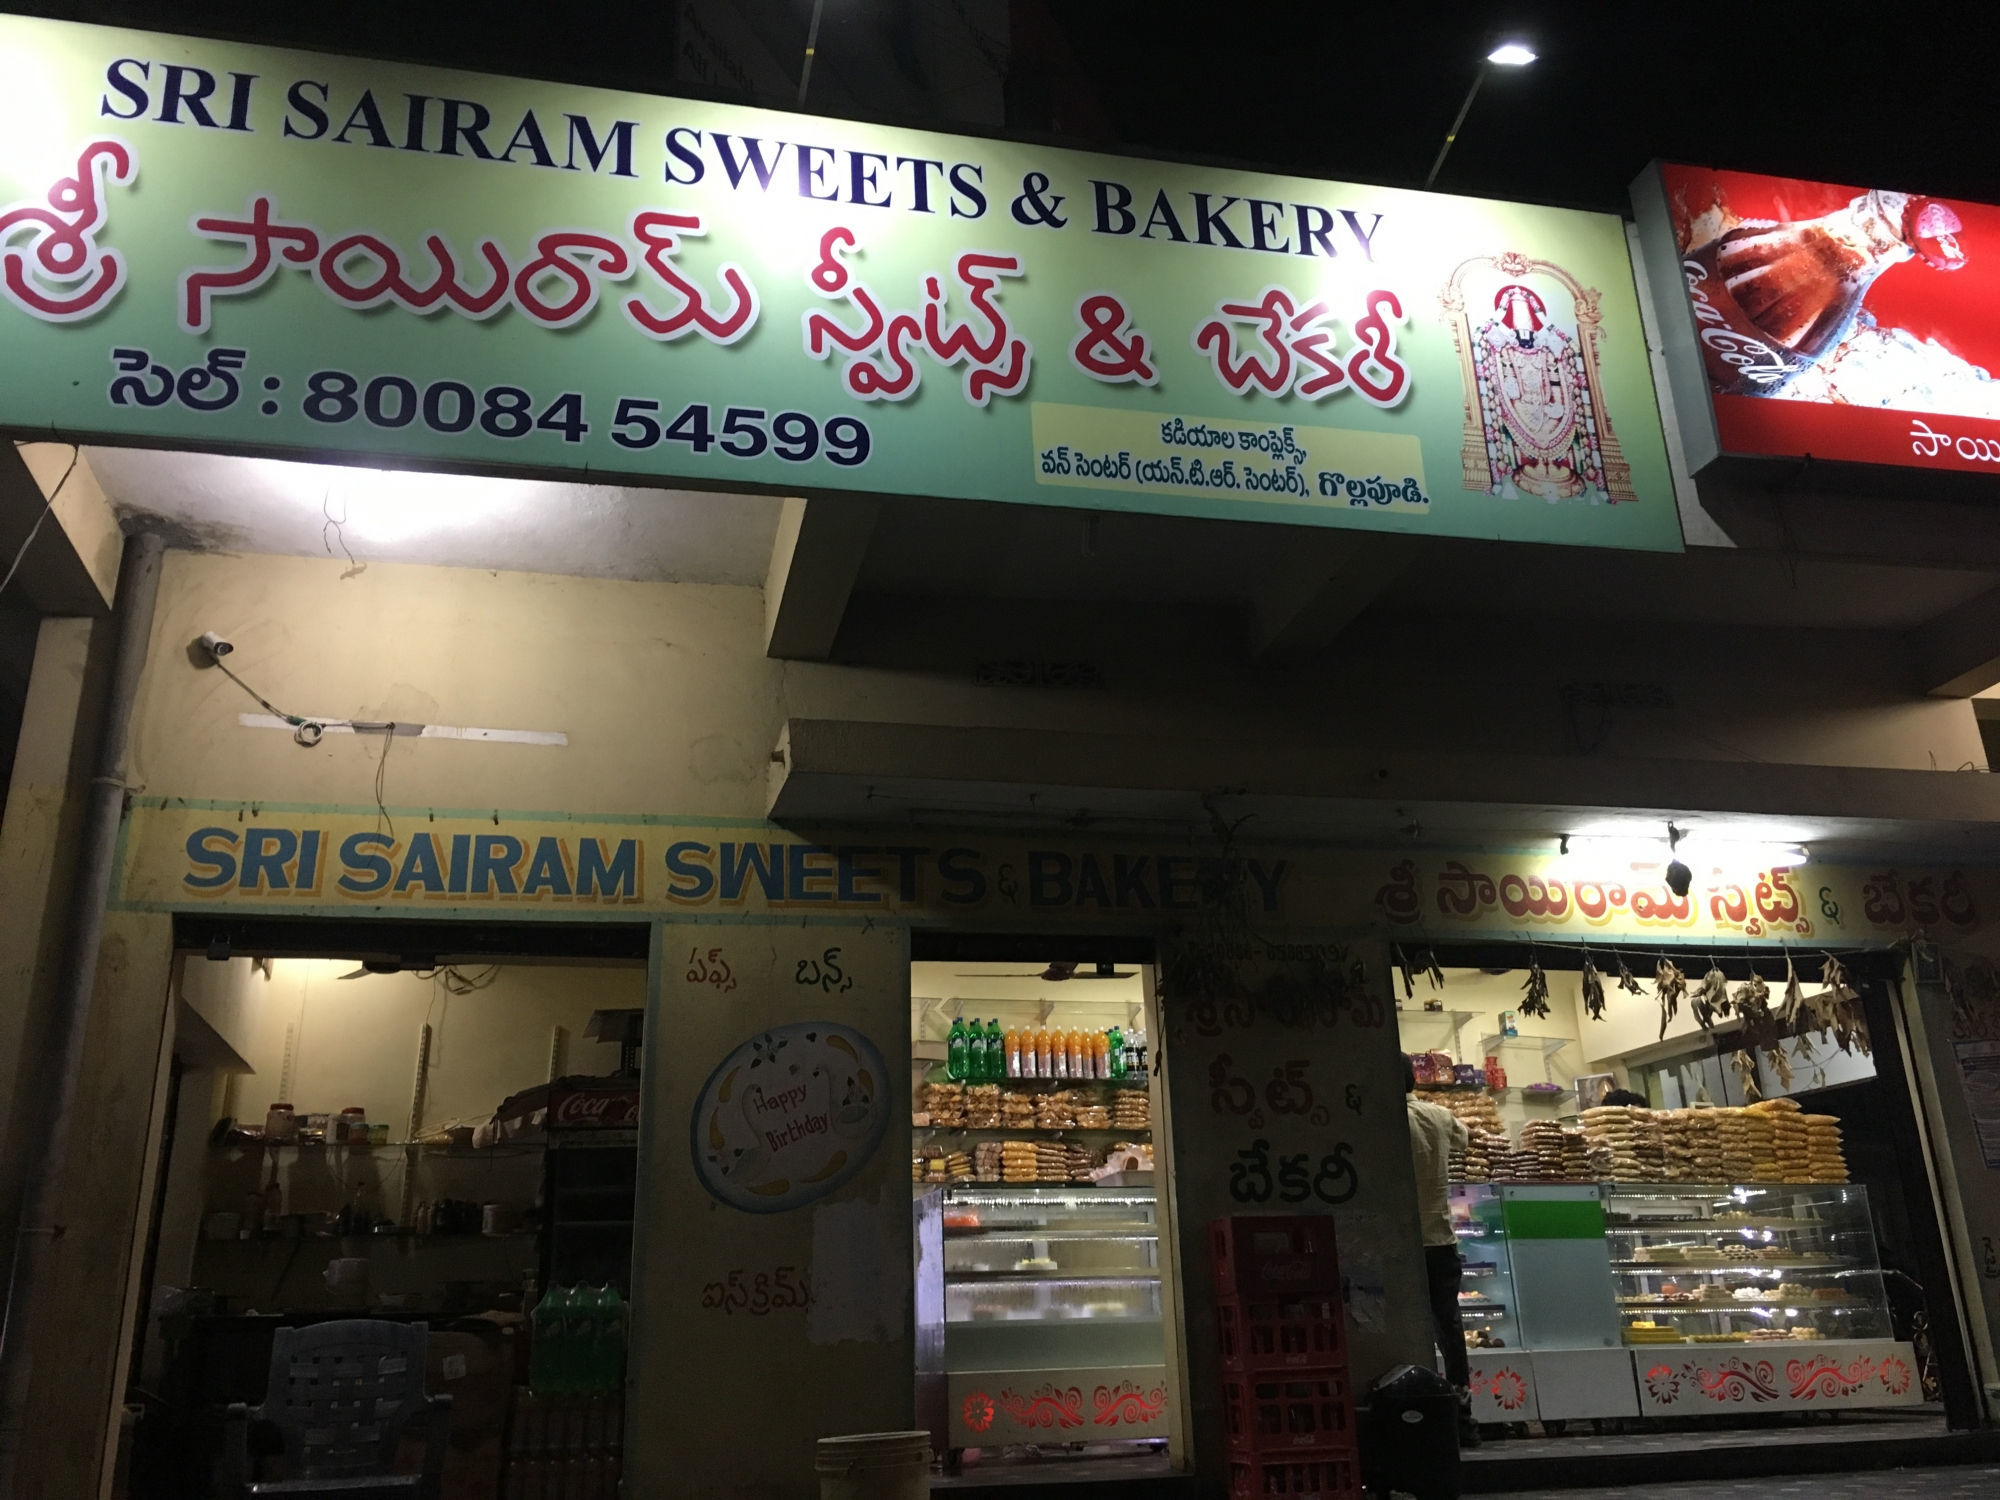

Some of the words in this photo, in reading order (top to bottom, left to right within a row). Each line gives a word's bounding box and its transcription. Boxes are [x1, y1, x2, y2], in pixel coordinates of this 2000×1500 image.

[101, 57, 260, 133] SRI
[282, 79, 641, 178] SAIRAM
[664, 126, 988, 219] SWEETS
[1010, 171, 1069, 229] &
[1087, 179, 1385, 262] BAKERY
[0, 140, 130, 316] శ్రీ
[808, 226, 1026, 401] స్వీట్స్
[1075, 294, 1154, 383] &
[1197, 289, 1405, 402] బేకరీ
[302, 371, 589, 443] 80084
[610, 398, 871, 466] 54599
[1161, 417, 1235, 448] కడియాల
[1075, 451, 1130, 480] సెంటర్
[182, 827, 321, 890] SRI
[338, 832, 638, 897] SAIRAM
[664, 841, 987, 906] SWEETS
[752, 1084, 807, 1113] Happy
[765, 1112, 828, 1153] Birthday
